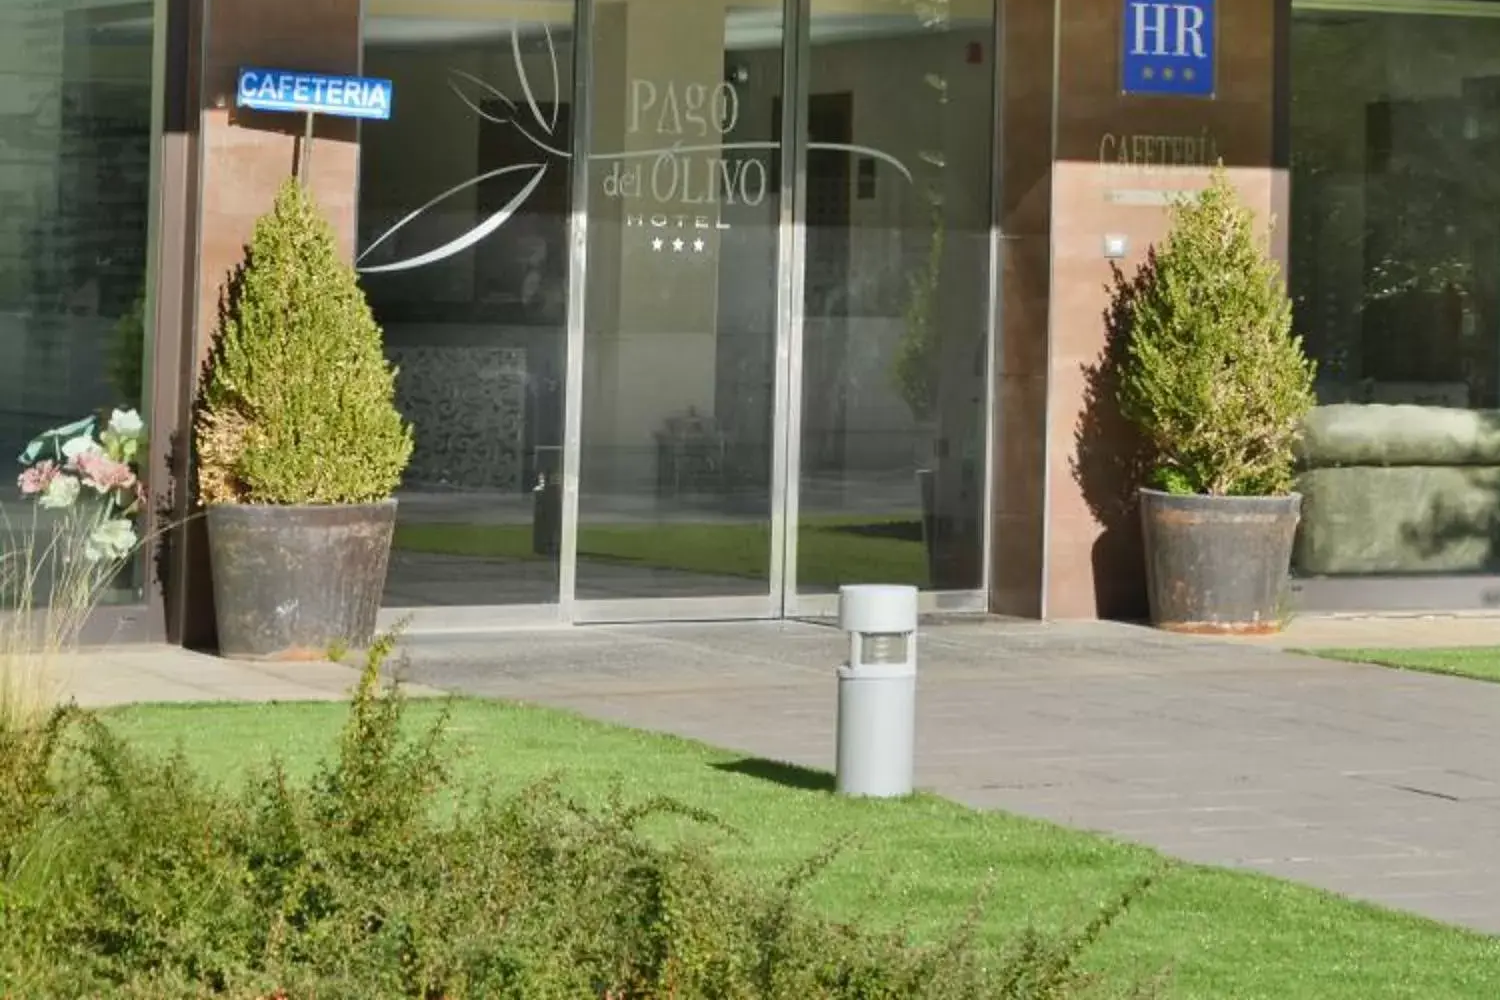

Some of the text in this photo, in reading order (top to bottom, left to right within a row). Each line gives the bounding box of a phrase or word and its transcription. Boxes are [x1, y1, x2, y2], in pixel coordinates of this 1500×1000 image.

[1130, 2, 1207, 58] HR
[240, 71, 387, 108] CAFETERIA
[603, 160, 642, 198] del
[626, 213, 732, 229] HOTEL
